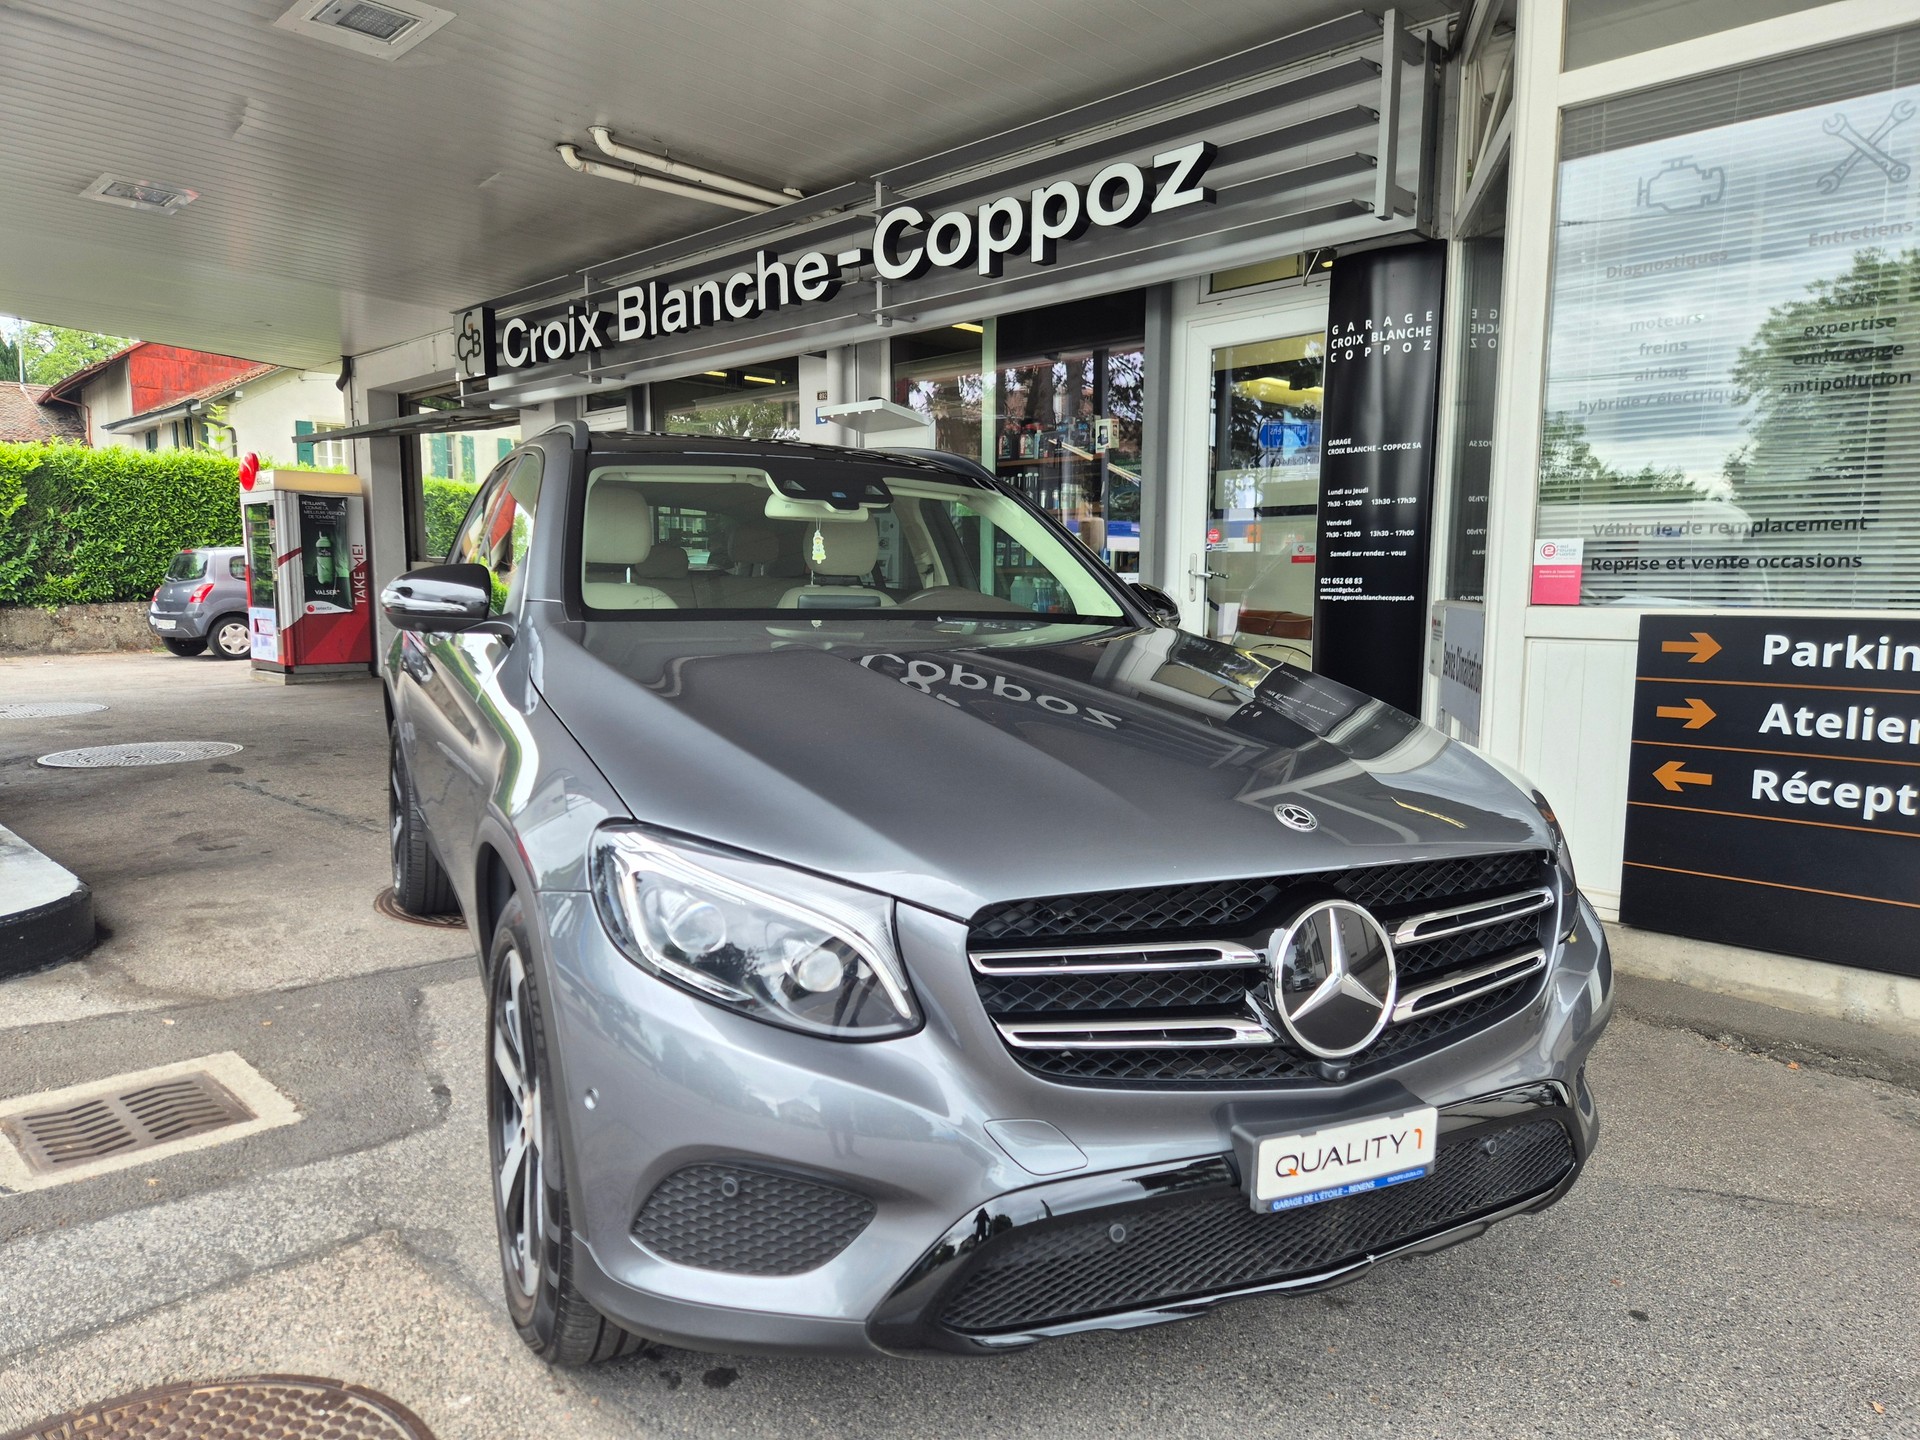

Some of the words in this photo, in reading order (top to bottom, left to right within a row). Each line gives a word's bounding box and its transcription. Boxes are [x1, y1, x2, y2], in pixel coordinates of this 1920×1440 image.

[1808, 221, 1914, 247] Entretiens
[1606, 250, 1729, 279] Diagnostiques
[1332, 311, 1433, 335] GARAGE
[1630, 312, 1702, 332] moteurs
[1803, 316, 1897, 337] expertise
[503, 305, 602, 367] Croix
[1331, 334, 1364, 349] CROIX
[1371, 325, 1432, 343] BLANCHE
[1330, 340, 1431, 363] COPPOZ
[1639, 340, 1688, 356] freins
[1793, 344, 1904, 365] embrayage
[1635, 367, 1688, 382] airbag
[1782, 372, 1911, 394] antipollution
[1578, 397, 1640, 415] hybride
[1328, 438, 1351, 447] GARAGE
[1346, 445, 1376, 454] BLANCHE
[1383, 443, 1411, 451] COPPOZ
[1593, 522, 1672, 537] Véhicule
[1679, 521, 1702, 536] de
[1709, 517, 1868, 537] remplacement
[1591, 556, 1660, 574] Reprise
[1665, 557, 1685, 570] et
[1691, 556, 1750, 570] vente
[1756, 553, 1863, 569] occasions
[354, 572, 367, 605] TAKE
[1763, 634, 1920, 672] Parkin
[1751, 769, 1918, 821] Récept
[1273, 1197, 1303, 1210] GARAGE
[1304, 1194, 1314, 1204] DE
[1349, 1180, 1375, 1194] RENENS
